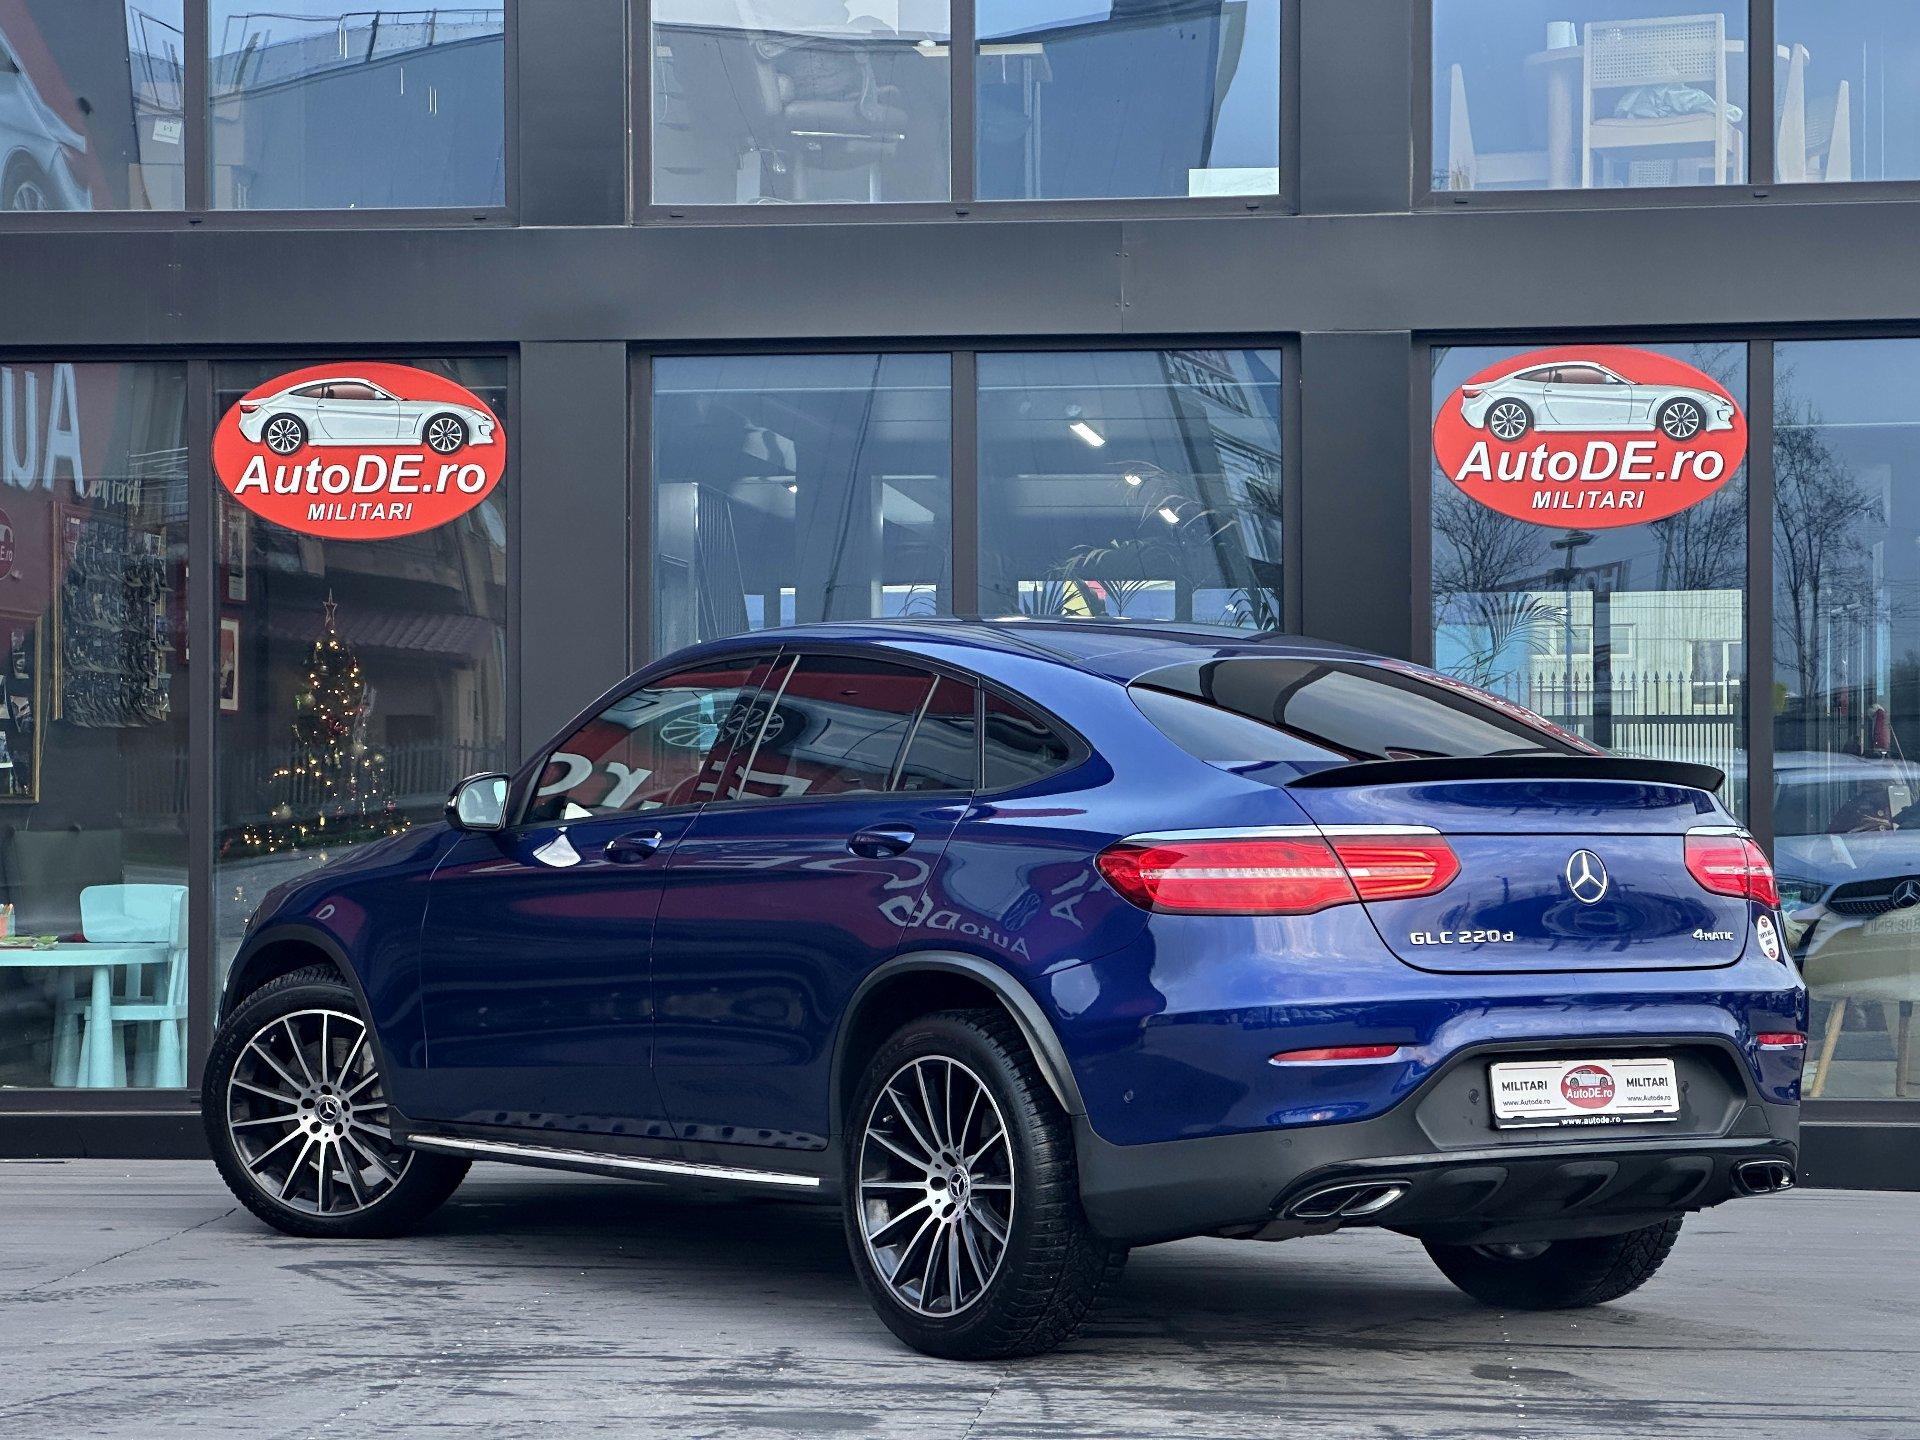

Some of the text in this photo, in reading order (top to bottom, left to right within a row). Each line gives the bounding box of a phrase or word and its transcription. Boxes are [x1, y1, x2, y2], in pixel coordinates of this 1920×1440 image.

[1454, 440, 1724, 482] AutoDE.ro
[233, 454, 487, 494] AutoDE.ro
[1531, 490, 1645, 510] MILITARI
[307, 502, 413, 521] MILITARI
[1409, 929, 1514, 945] GLC 220d
[1692, 928, 1734, 941] 4MATIC
[1501, 1080, 1548, 1092] MILITARI
[1626, 1076, 1669, 1088] MILITARI
[1566, 1087, 1613, 1100] AutoDE.ro
[1502, 1098, 1551, 1107] www.Autode.ro
[1560, 1115, 1622, 1126] www.autode.ro
